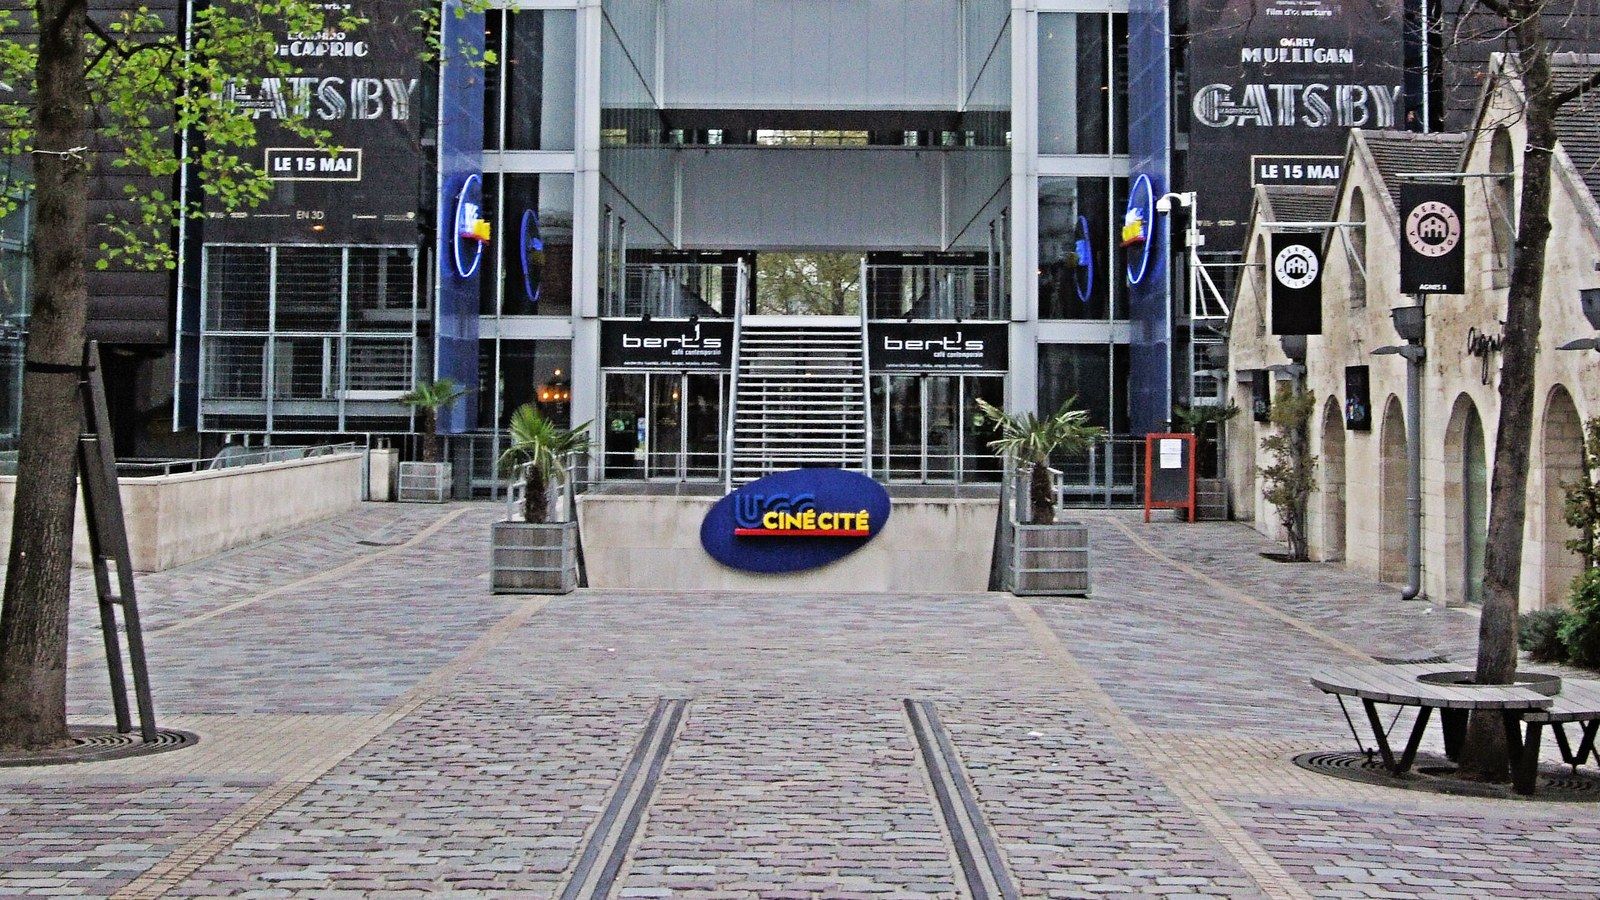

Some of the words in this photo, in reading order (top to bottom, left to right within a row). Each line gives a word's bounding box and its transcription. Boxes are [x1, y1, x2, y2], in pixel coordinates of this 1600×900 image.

[1284, 8, 1333, 17] d'overture
[1241, 48, 1354, 63] MULLIGAN
[1192, 84, 1401, 128] GATSBY
[274, 158, 291, 171] LE
[297, 158, 315, 171] 15
[320, 158, 352, 172] MAI
[1261, 165, 1280, 178] LE
[1283, 165, 1303, 178] 15
[1307, 165, 1340, 179] MAI
[623, 324, 722, 348] bert's
[884, 331, 984, 350] bert's
